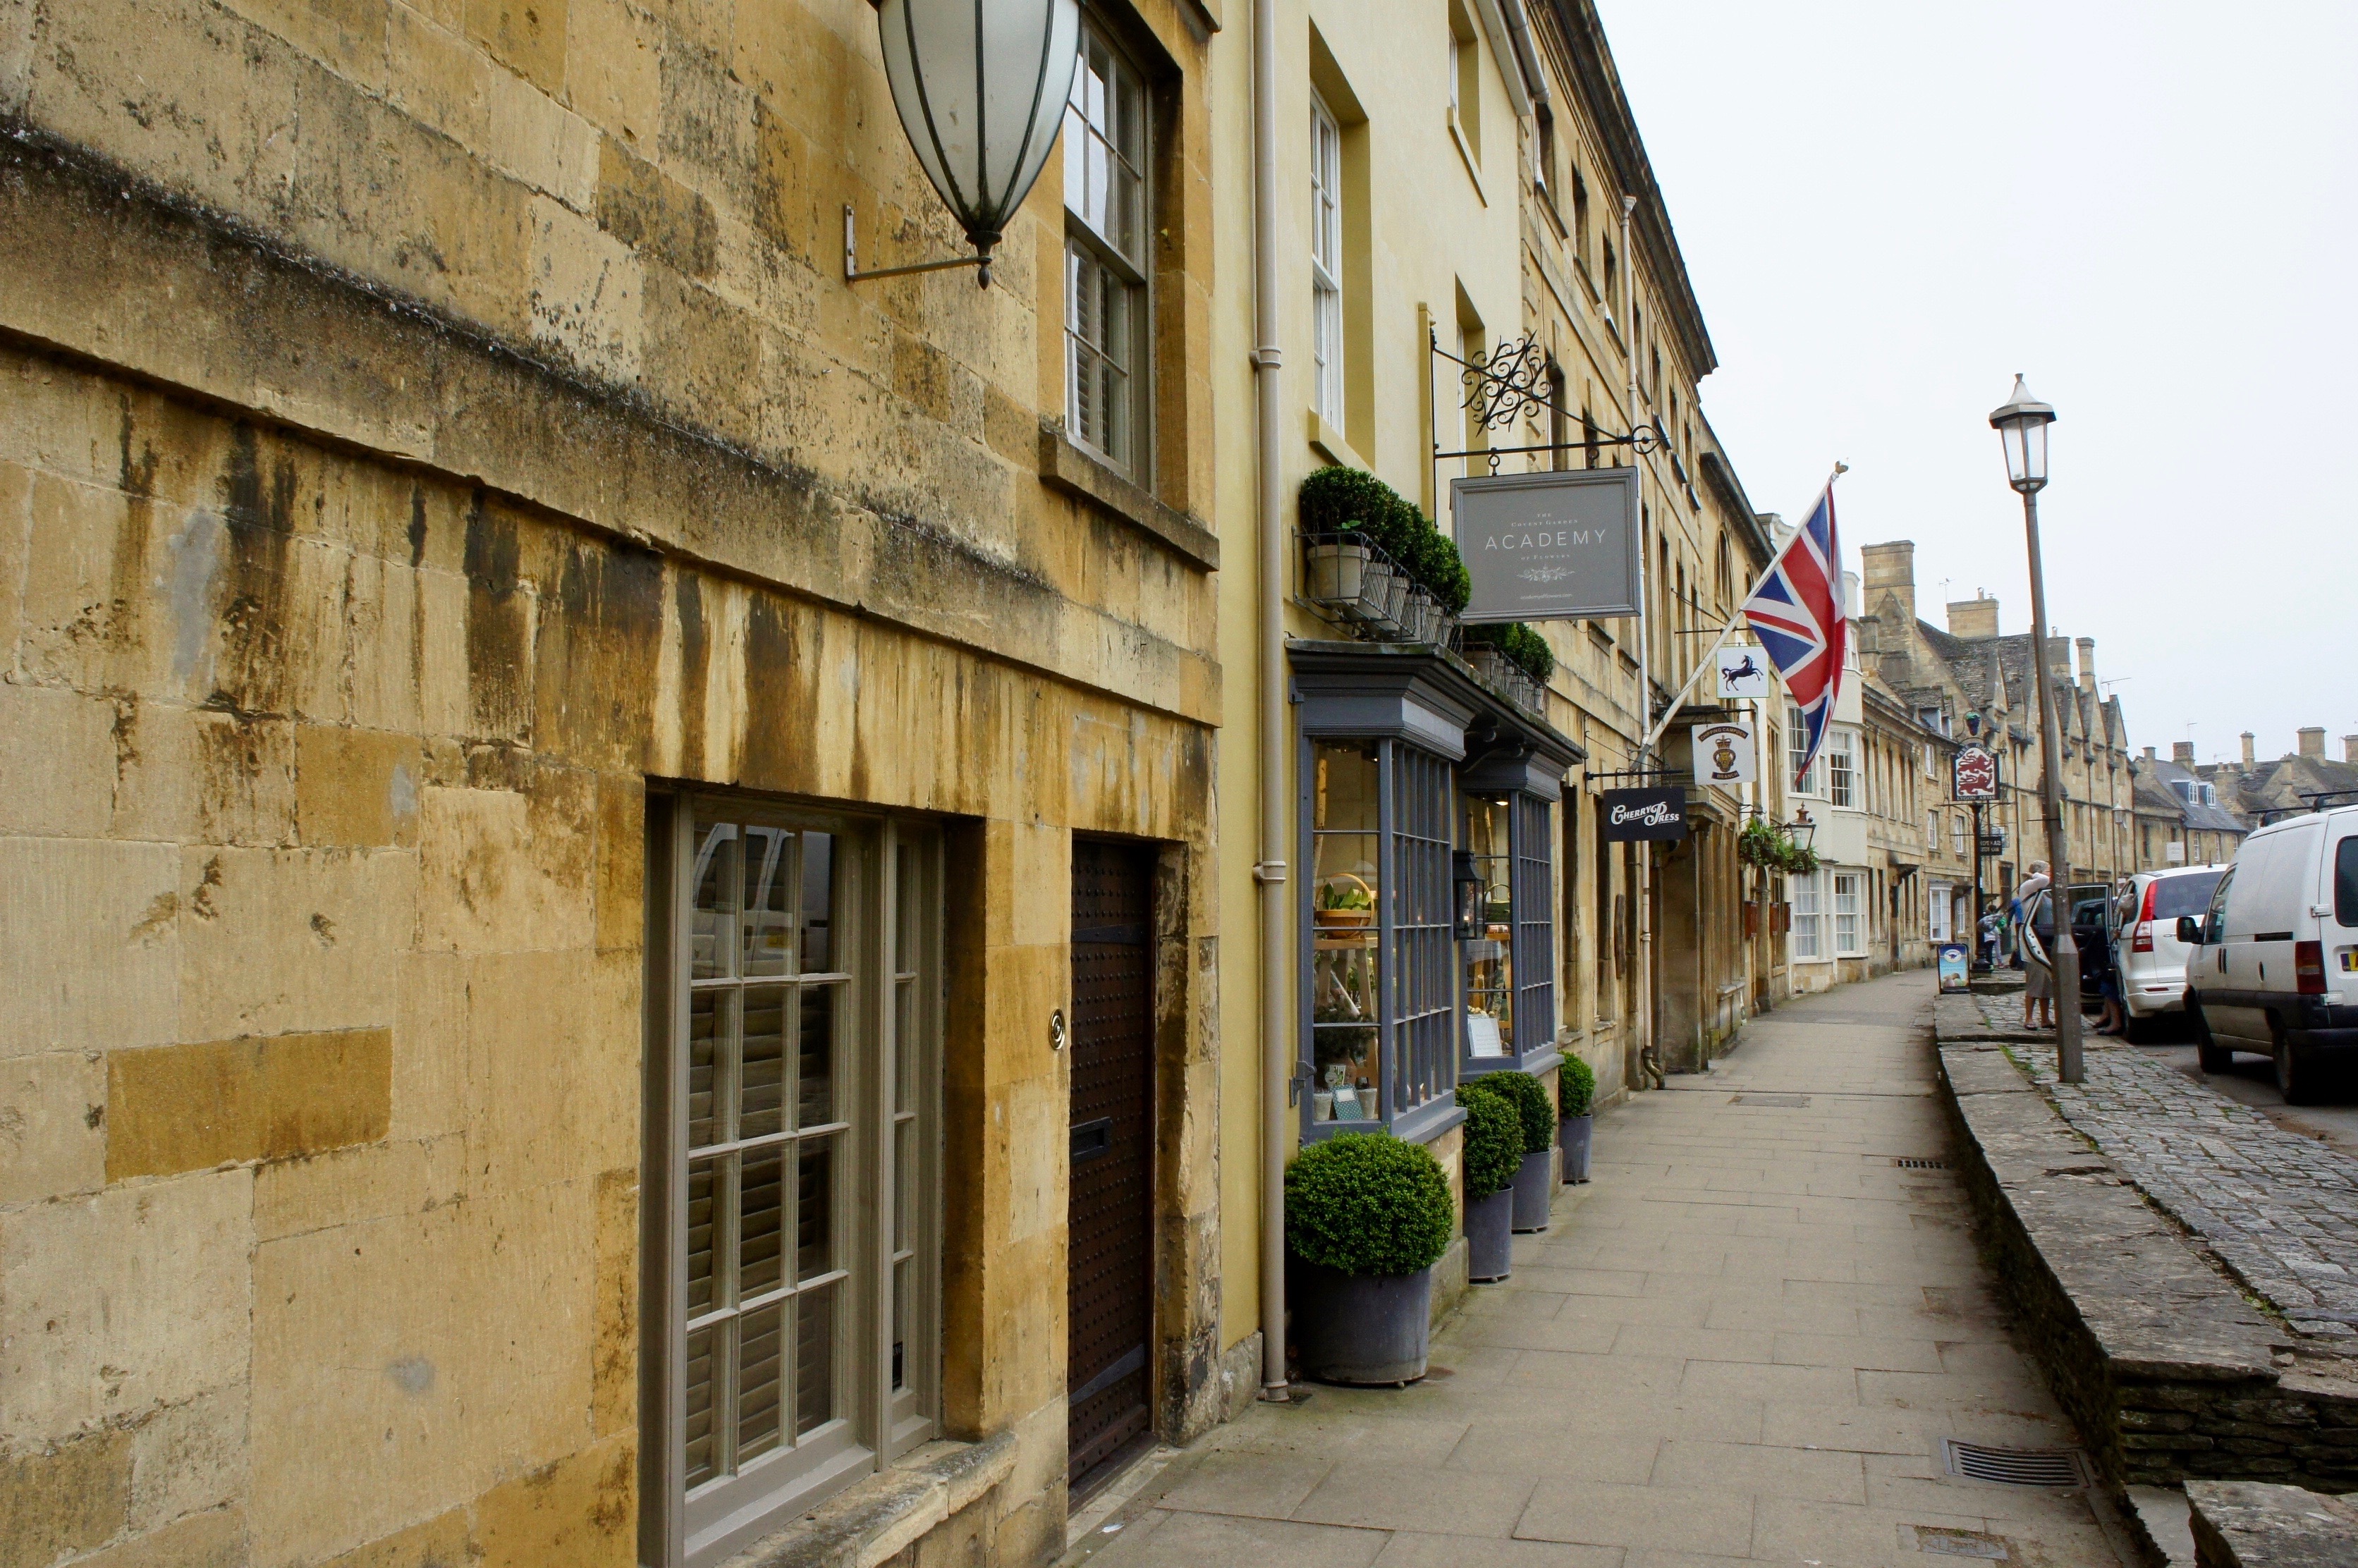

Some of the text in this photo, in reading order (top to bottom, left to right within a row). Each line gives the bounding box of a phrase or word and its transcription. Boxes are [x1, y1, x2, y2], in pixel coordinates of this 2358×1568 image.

[1484, 529, 1606, 551] ACADEMY
[1700, 728, 1747, 740] CHIPPING CAMPDEN
[1611, 801, 1680, 826] CHERRY PRESS
